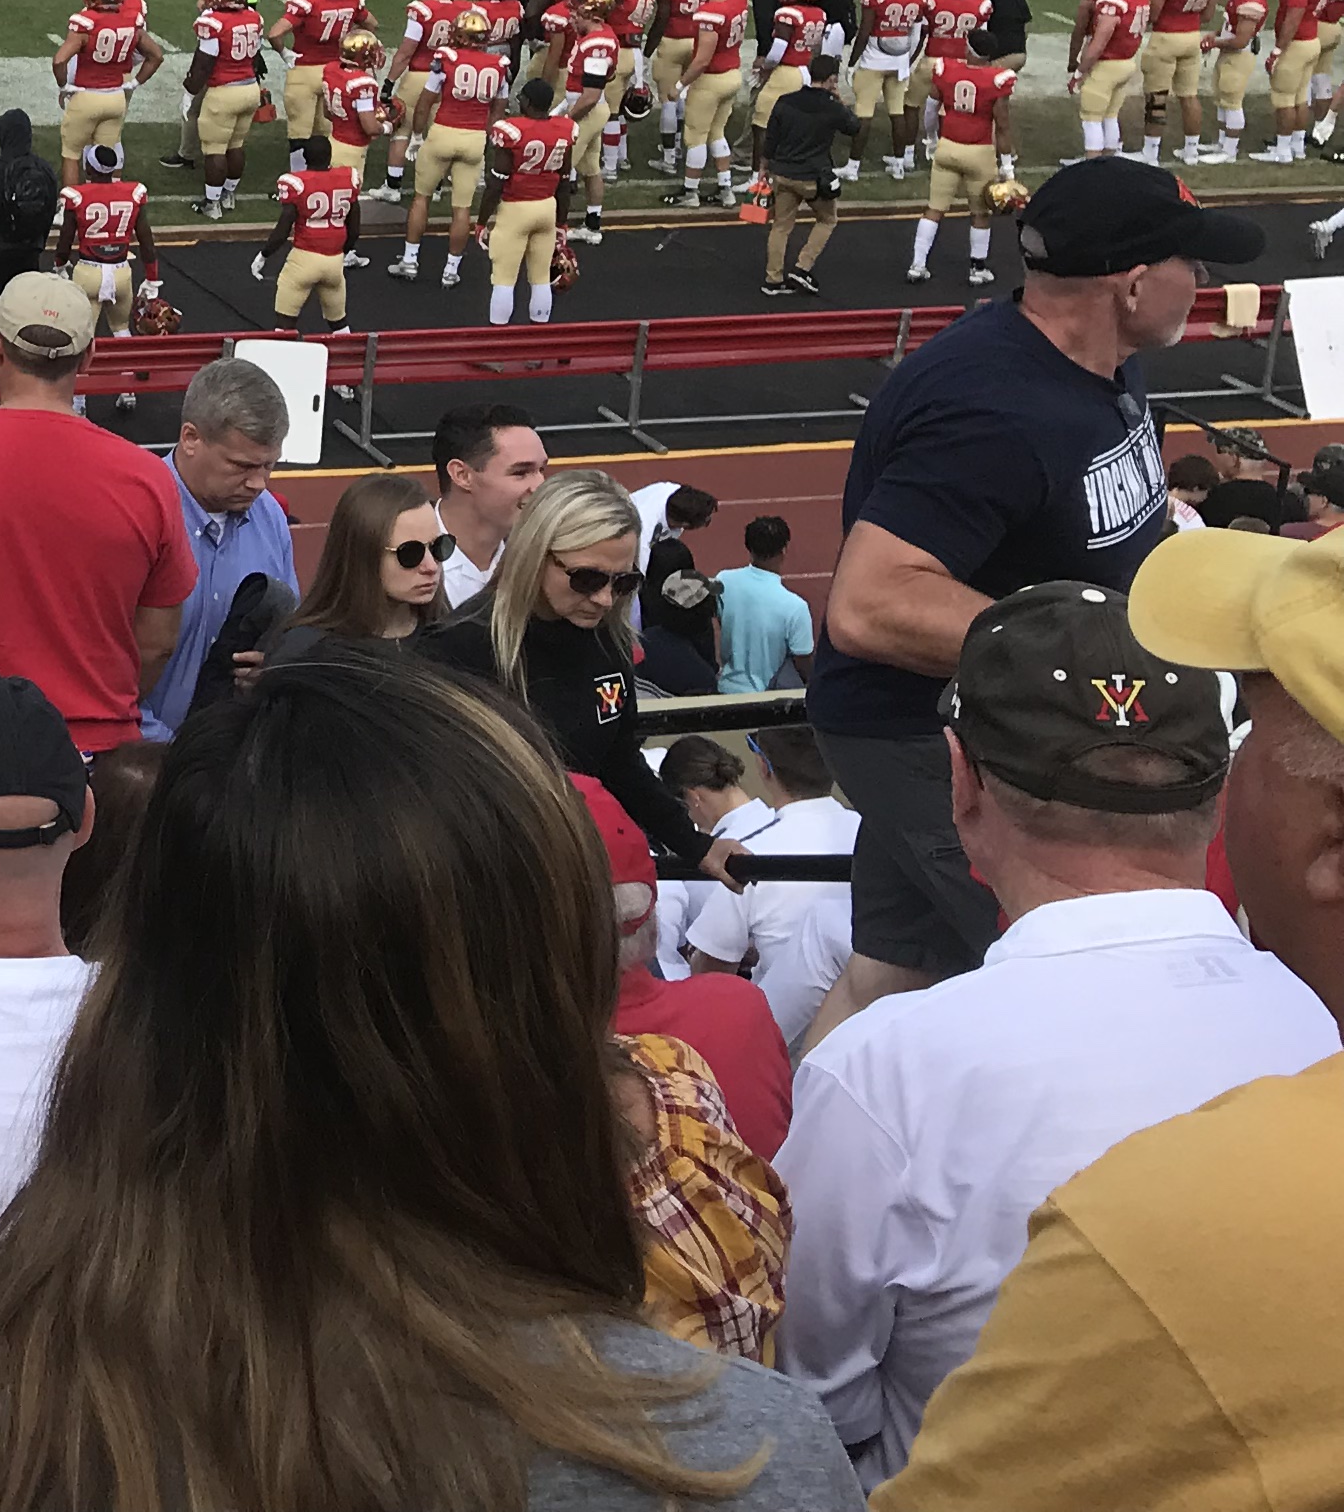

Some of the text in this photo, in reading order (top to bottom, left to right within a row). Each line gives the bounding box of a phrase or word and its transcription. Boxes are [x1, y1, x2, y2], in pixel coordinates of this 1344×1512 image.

[230, 23, 263, 61] 55
[320, 7, 355, 42] 77
[92, 27, 136, 65] 97
[452, 63, 501, 104] 90
[522, 139, 566, 177] 24
[83, 200, 135, 239] 27
[304, 188, 352, 230] 25
